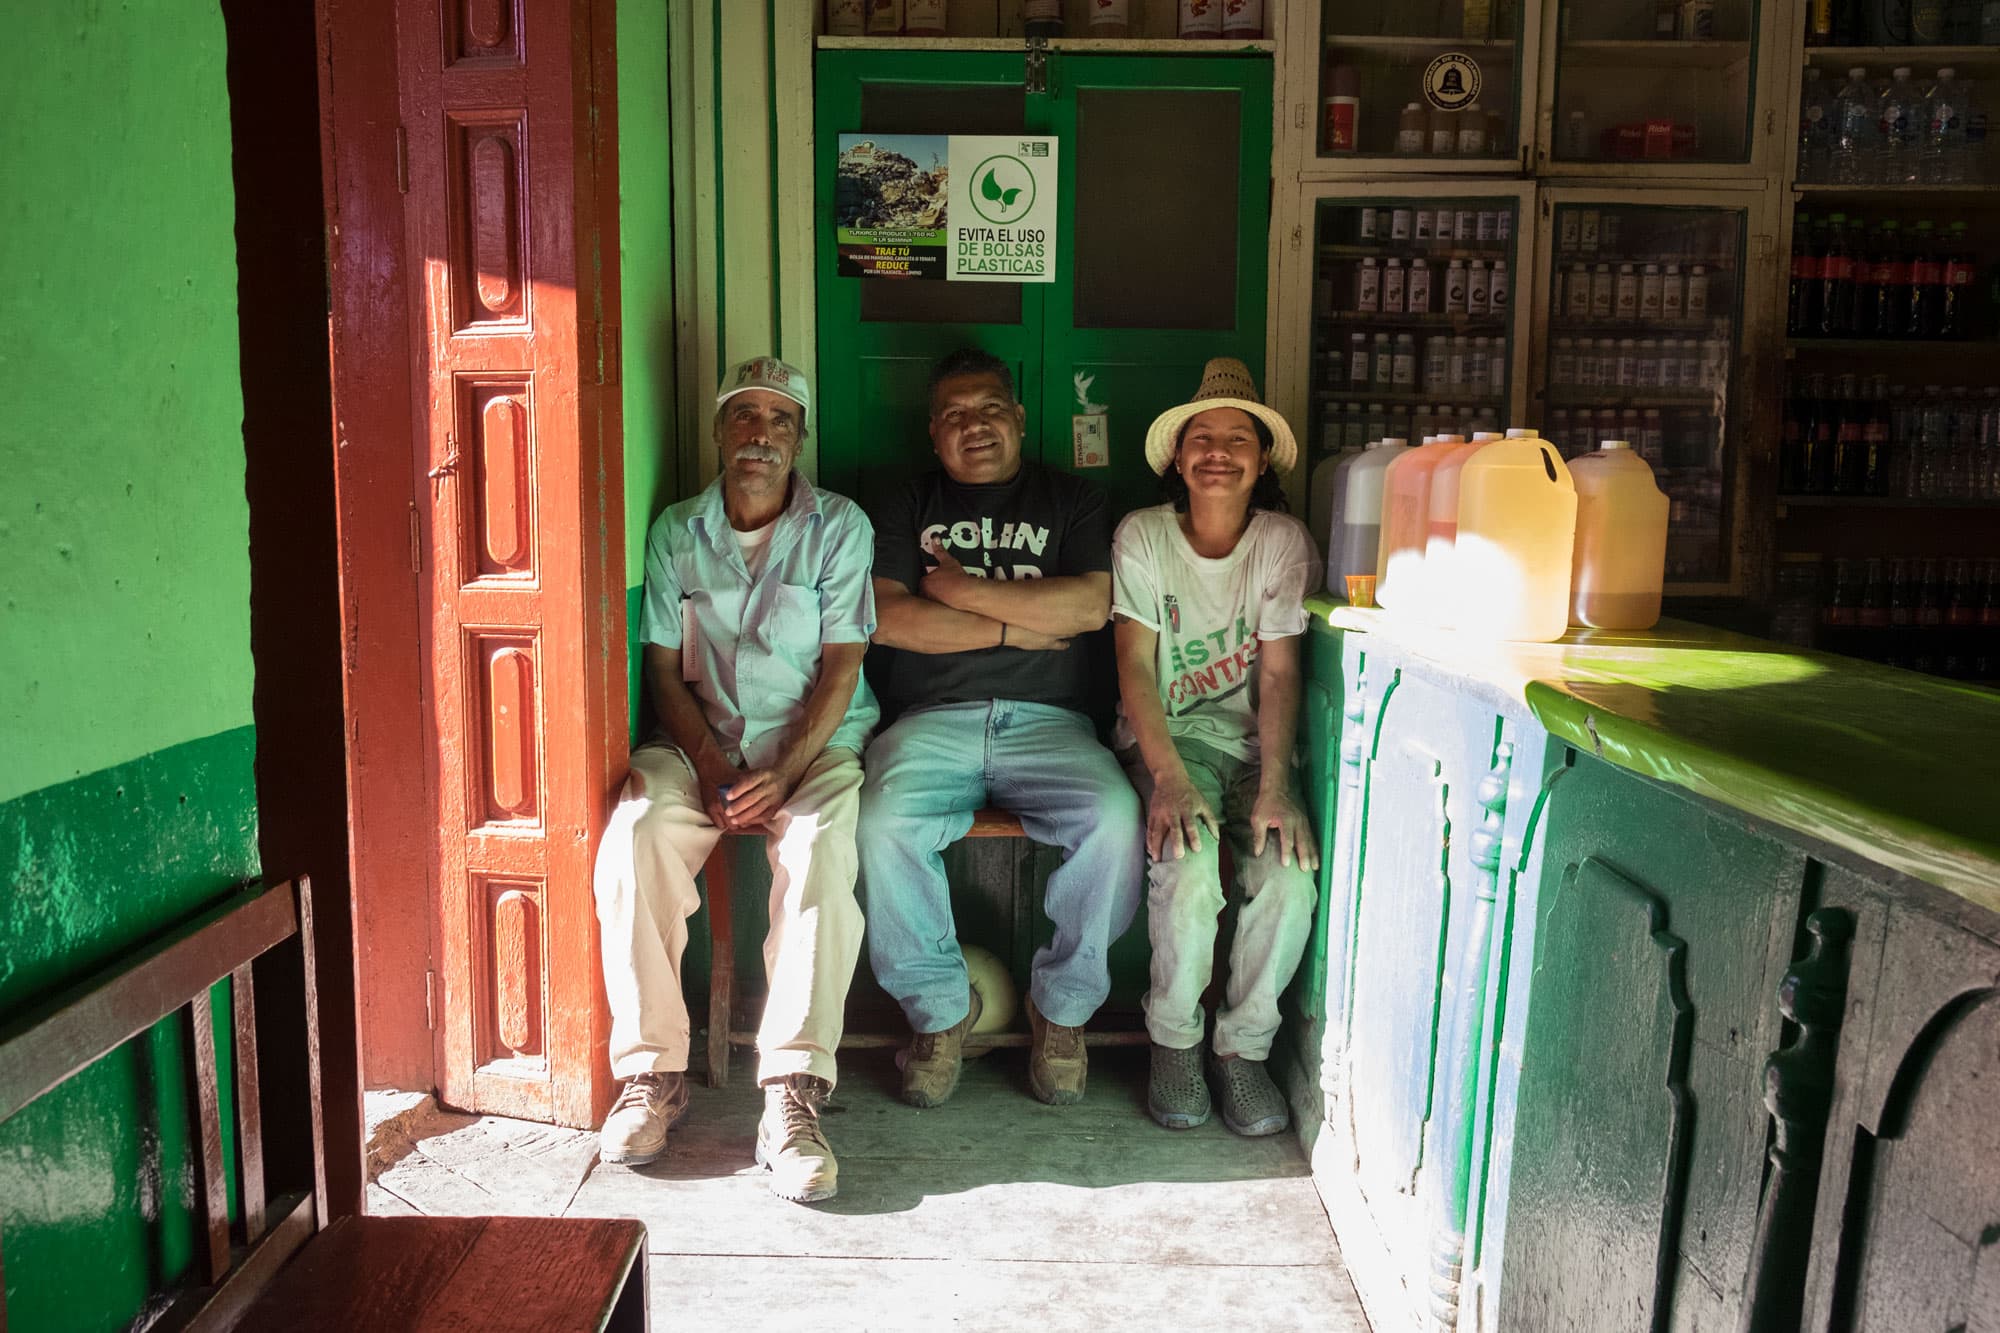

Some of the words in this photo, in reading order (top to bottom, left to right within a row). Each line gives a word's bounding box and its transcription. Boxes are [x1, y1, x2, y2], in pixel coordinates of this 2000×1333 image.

[958, 227, 995, 241] EVITA
[998, 229, 1014, 242] EL
[1017, 229, 1045, 243] USO
[875, 247, 897, 256] TRAE
[898, 245, 910, 256] TÚ
[958, 242, 978, 256] DE
[982, 243, 1045, 257] BOLSAS
[876, 261, 910, 270] REDUCE
[957, 258, 1045, 272] PLASTICAS
[920, 515, 1050, 557] COLIN
